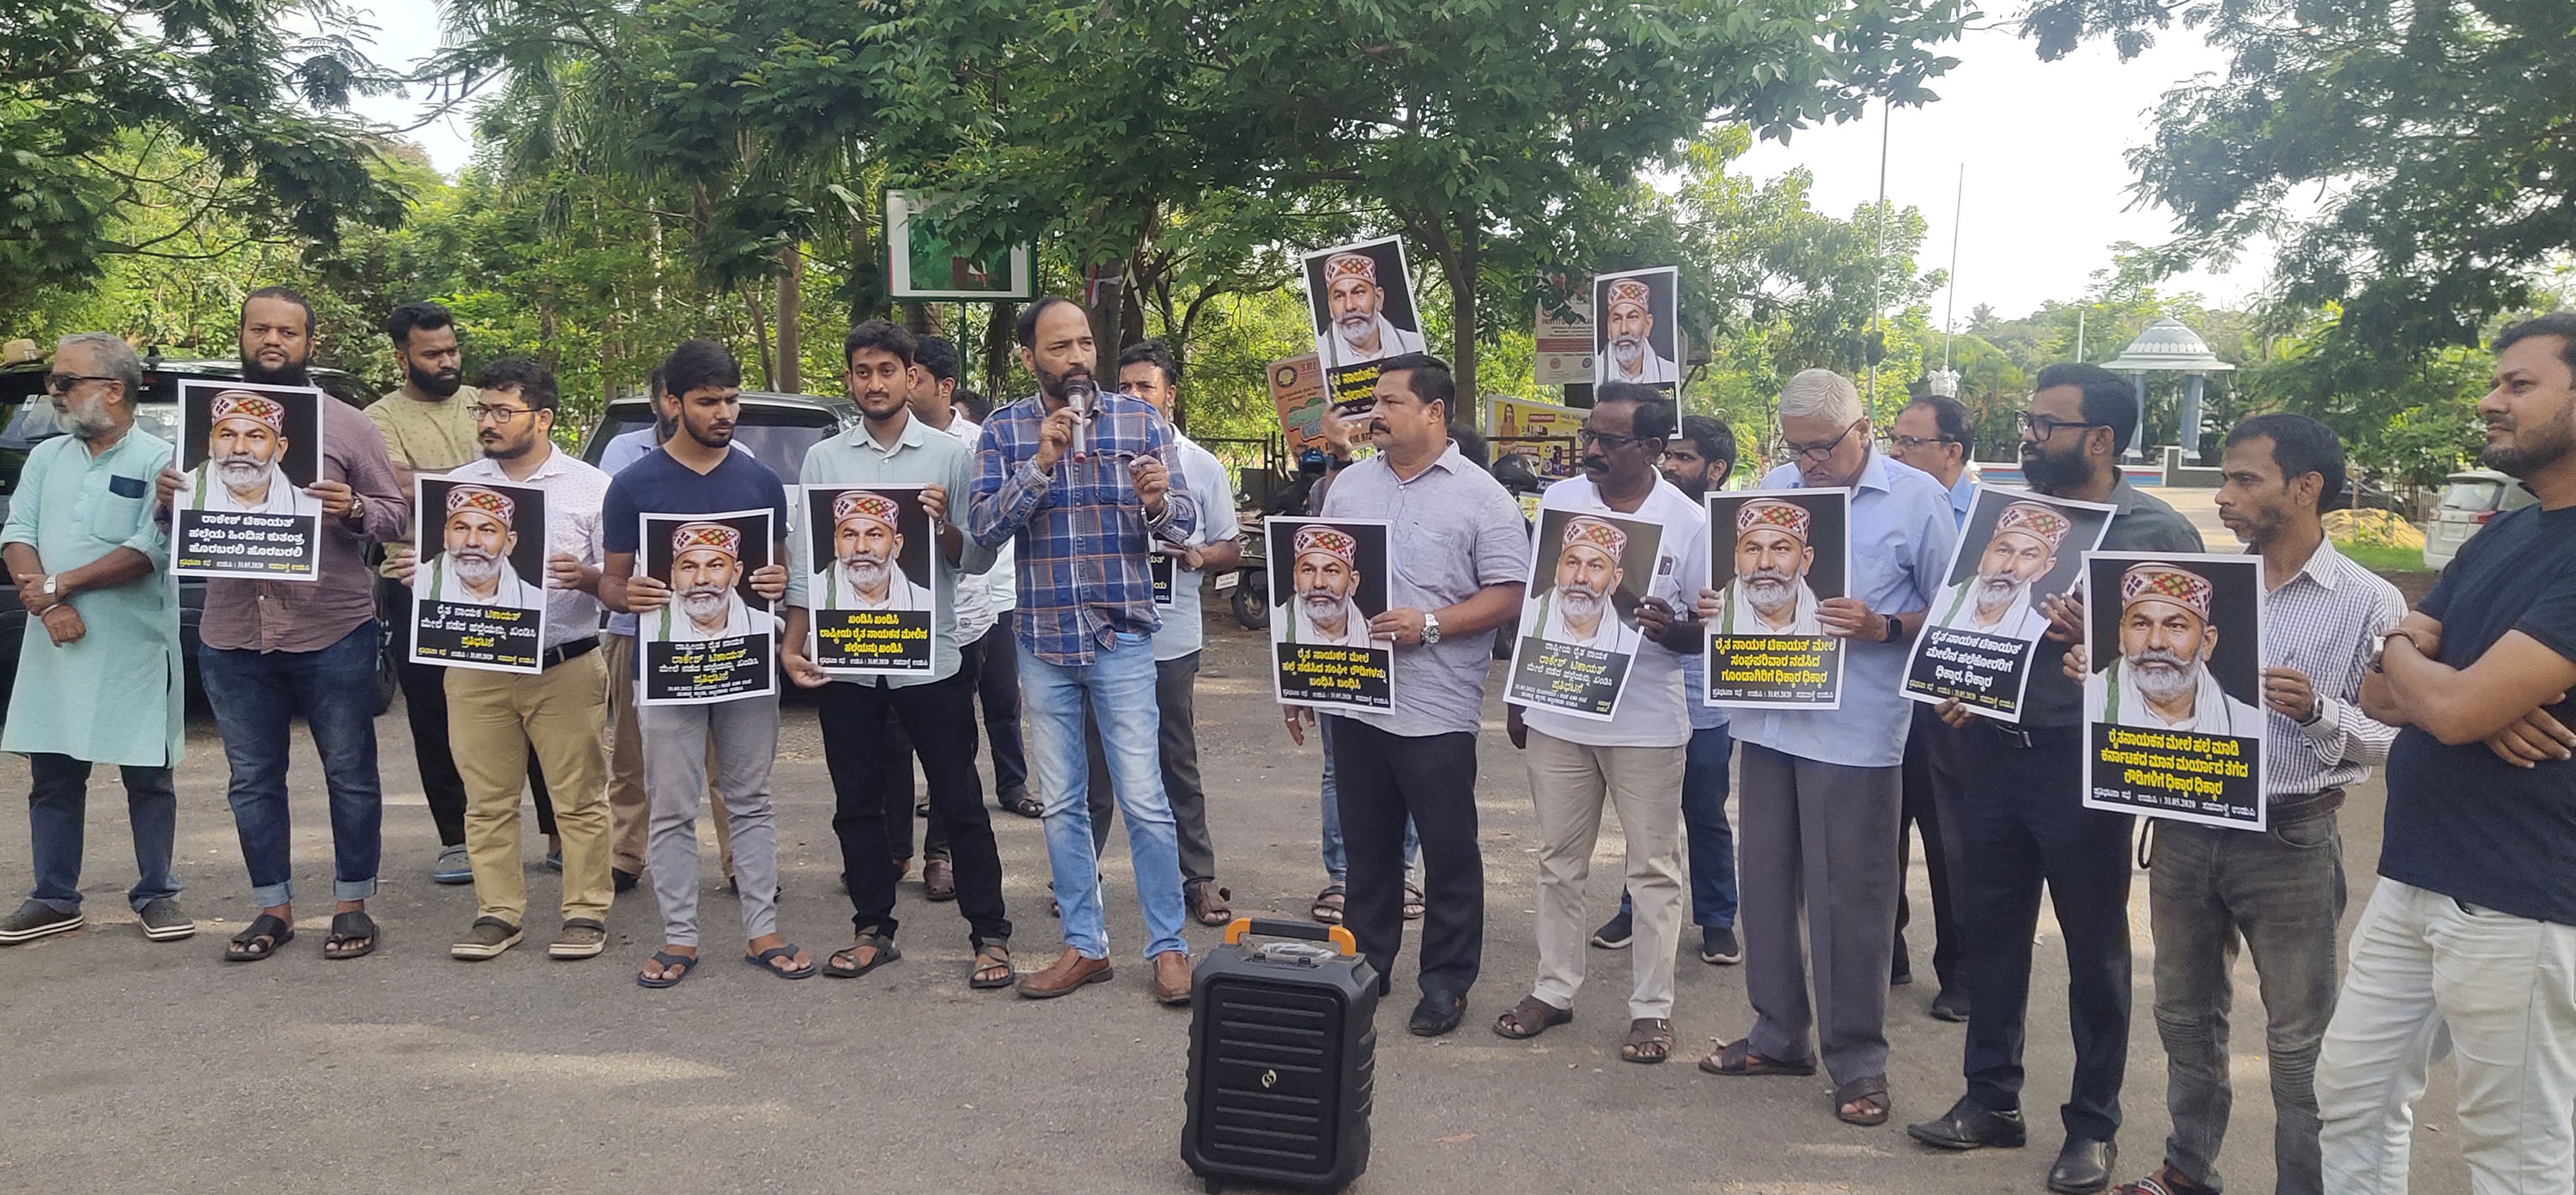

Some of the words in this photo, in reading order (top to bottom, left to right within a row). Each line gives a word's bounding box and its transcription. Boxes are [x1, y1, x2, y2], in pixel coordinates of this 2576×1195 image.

[202, 514, 241, 524] ರಾಕೇಶ್
[189, 529, 226, 543] ಹಲ್ಲೆಯ
[228, 531, 264, 541] ಹಿಂದಿನ
[268, 532, 305, 545] ಕುತಂತ್ರ
[189, 543, 245, 555] ಹೊರಬರಲಿ
[247, 545, 303, 557] ಹೊರಬರಲಿ
[437, 604, 452, 619] ರೈತ
[454, 607, 481, 619] ನಾಯಕ
[848, 613, 872, 624] ಖಂಡಿಸಿ
[874, 614, 899, 624] ಖಂಡಿಸಿ
[421, 617, 443, 628] ಮೇಲೆ
[446, 622, 465, 631] ನಡೆದ
[470, 622, 507, 640] ಹಲ್ಲೆಯನ್ನು
[509, 627, 536, 638] ಖಂಡಿಸಿ
[820, 628, 852, 644] ರಾಷ್ಟ್ರೀಯ
[853, 628, 866, 641] ರೈತ
[867, 629, 900, 639] ನಾಯಕನ
[902, 628, 927, 639] ಮೇಲಿನ
[1931, 630, 1948, 645] ರೈತ
[1947, 635, 1978, 646] ನಾಯಕ
[845, 642, 878, 657] ಹಲ್ಲೆಯನ್ನು
[878, 642, 903, 652] ಖಂಡಿಸಿ
[1716, 638, 1731, 655] ರೈತ
[1733, 639, 1766, 651] ನಾಯಕ
[1813, 639, 1837, 651] ಮೇಲೆ
[1297, 648, 1310, 662] ರೈತ
[1349, 652, 1369, 663] ಮೇಲೆ
[1539, 654, 1567, 668] ರಾಕೇಶ್
[1731, 654, 1789, 668] ಸಂಘಪರಿವಾರ
[1789, 656, 1820, 667] ನಡೆಸಿದ
[1926, 647, 1958, 662] ಮೇಲಿನ
[1957, 653, 2014, 672] ಹಲ್ಲೆಕೋರರಿಗೆ
[1309, 676, 1334, 688] ಬಂಧಿಸಿ
[1337, 677, 1361, 691] ಬಂಧಿಸಿ
[1776, 670, 1801, 688] ಧಿಕ್ಕಾರ
[1802, 670, 1827, 688] ಧಿಕ್ಕಾರ
[1935, 666, 1963, 685] ಧಿಕ್ಕಾರ,
[1965, 671, 1993, 692] ಧಿಕ್ಕಾರ
[2166, 735, 2191, 750] ಮೇಲೆ
[2193, 738, 2212, 760] ಹಲ್ಲೆ
[2212, 740, 2239, 755] ಮಾಡಿ
[2101, 749, 2147, 766] ಕರ್ನಾಟಕದ
[2149, 754, 2174, 767] ಮಾನ
[2176, 758, 2223, 774] ಮರ್ಯಾದೆ
[2226, 762, 2248, 778] ತೆಗೆದ
[2124, 768, 2164, 787] ರೌಡಿಗಳಿಗೆ
[2166, 774, 2193, 798] ಧಿಕ್ಕಾರ
[2195, 778, 2222, 801] ಧಿಕ್ಕಾರ
